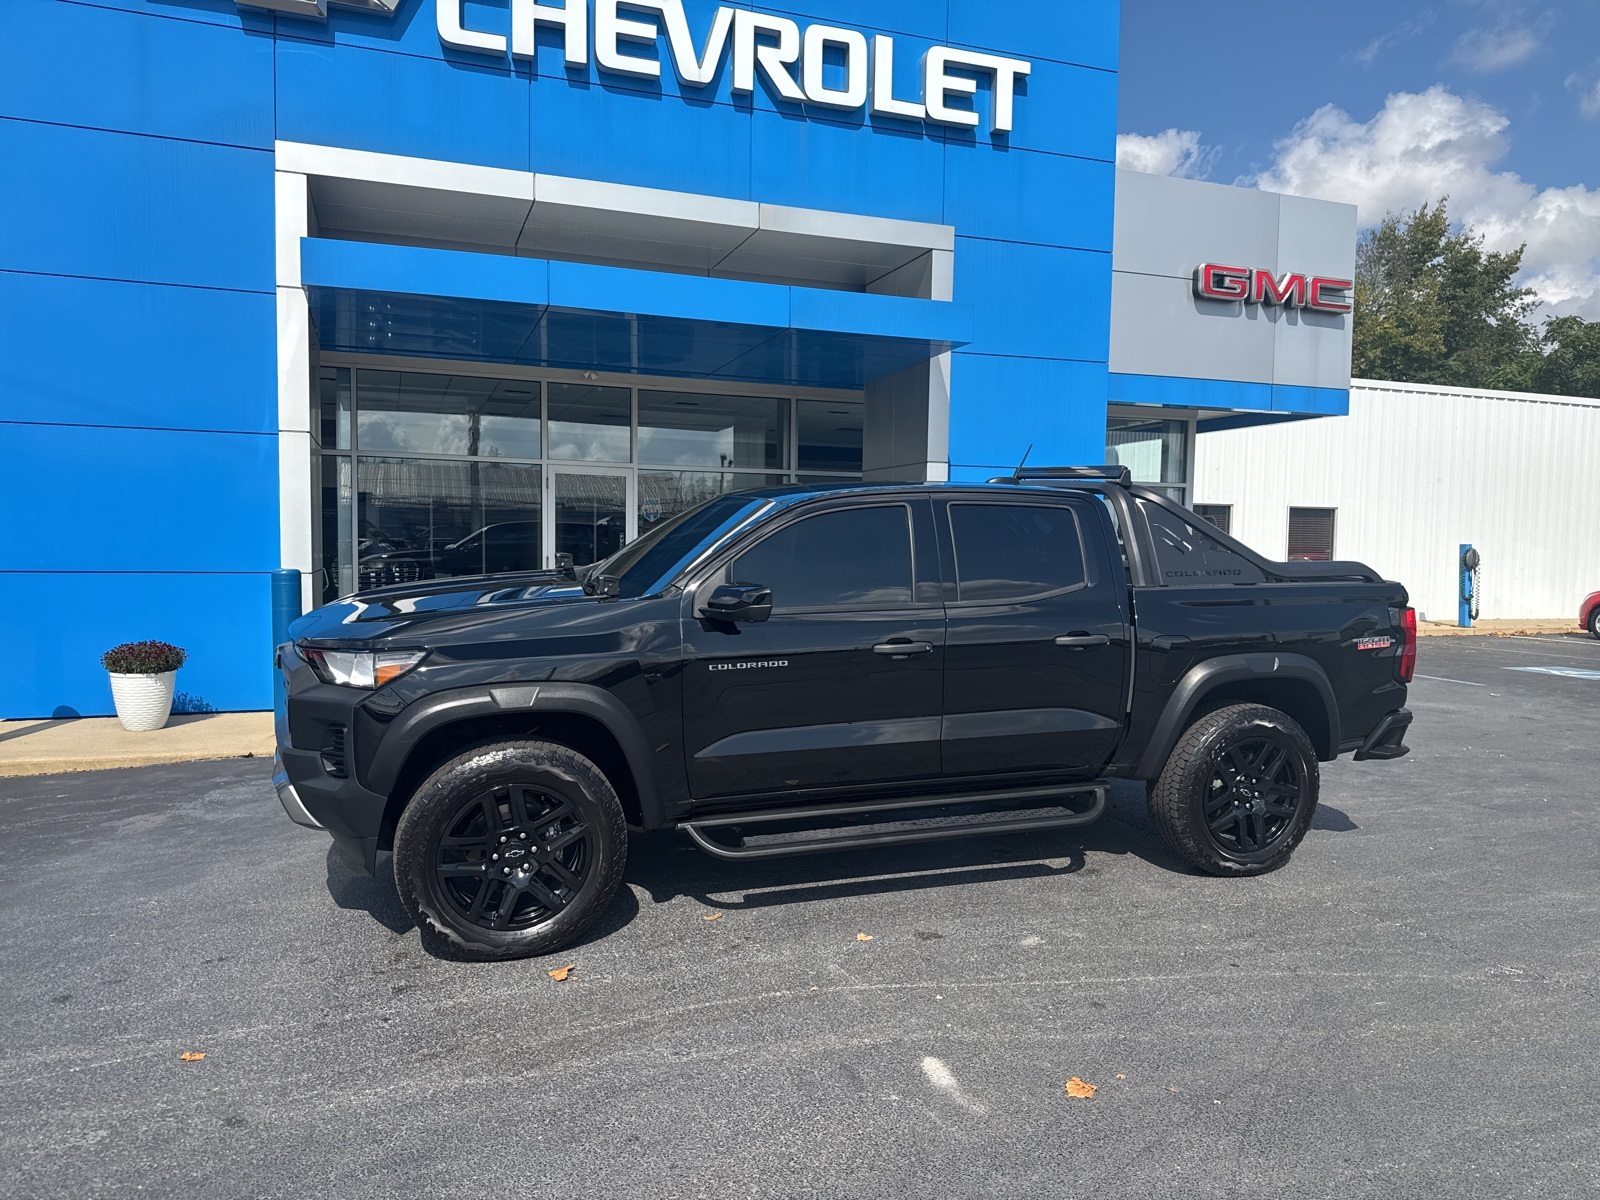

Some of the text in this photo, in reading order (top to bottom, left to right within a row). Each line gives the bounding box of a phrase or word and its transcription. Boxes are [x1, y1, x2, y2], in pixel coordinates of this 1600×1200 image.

[436, 0, 1031, 133] CHEVROLET
[1193, 263, 1353, 314] GMC
[1165, 569, 1242, 578] COLORADO
[708, 660, 788, 671] COLORADO
